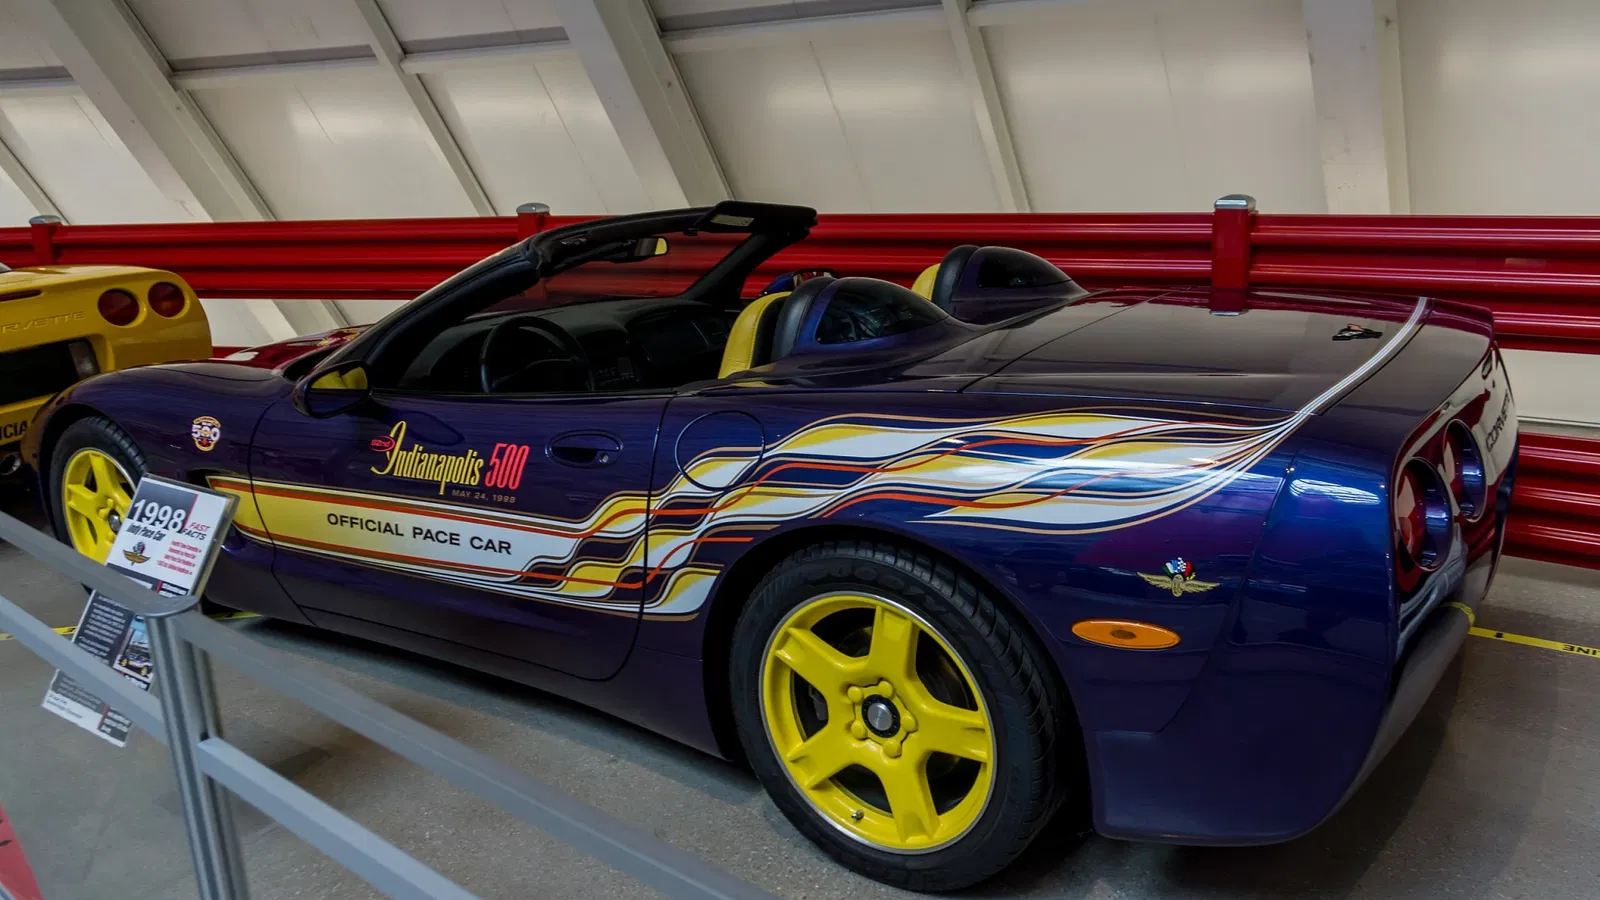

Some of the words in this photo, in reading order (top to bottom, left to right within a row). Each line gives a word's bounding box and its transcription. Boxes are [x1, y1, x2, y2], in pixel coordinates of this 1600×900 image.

[370, 420, 484, 495] Indianapolis
[485, 442, 530, 490] 500
[452, 489, 471, 499] MAY
[493, 493, 516, 504] 1998
[131, 498, 187, 534] 1998
[140, 526, 155, 539] Pace
[152, 529, 167, 542] Car
[182, 528, 208, 541] FACTS
[189, 522, 211, 532] FAST
[327, 513, 404, 536] OFFICIAL
[412, 527, 460, 546] PACE
[470, 536, 512, 555] CAR
[1562, 644, 1600, 656] INE
